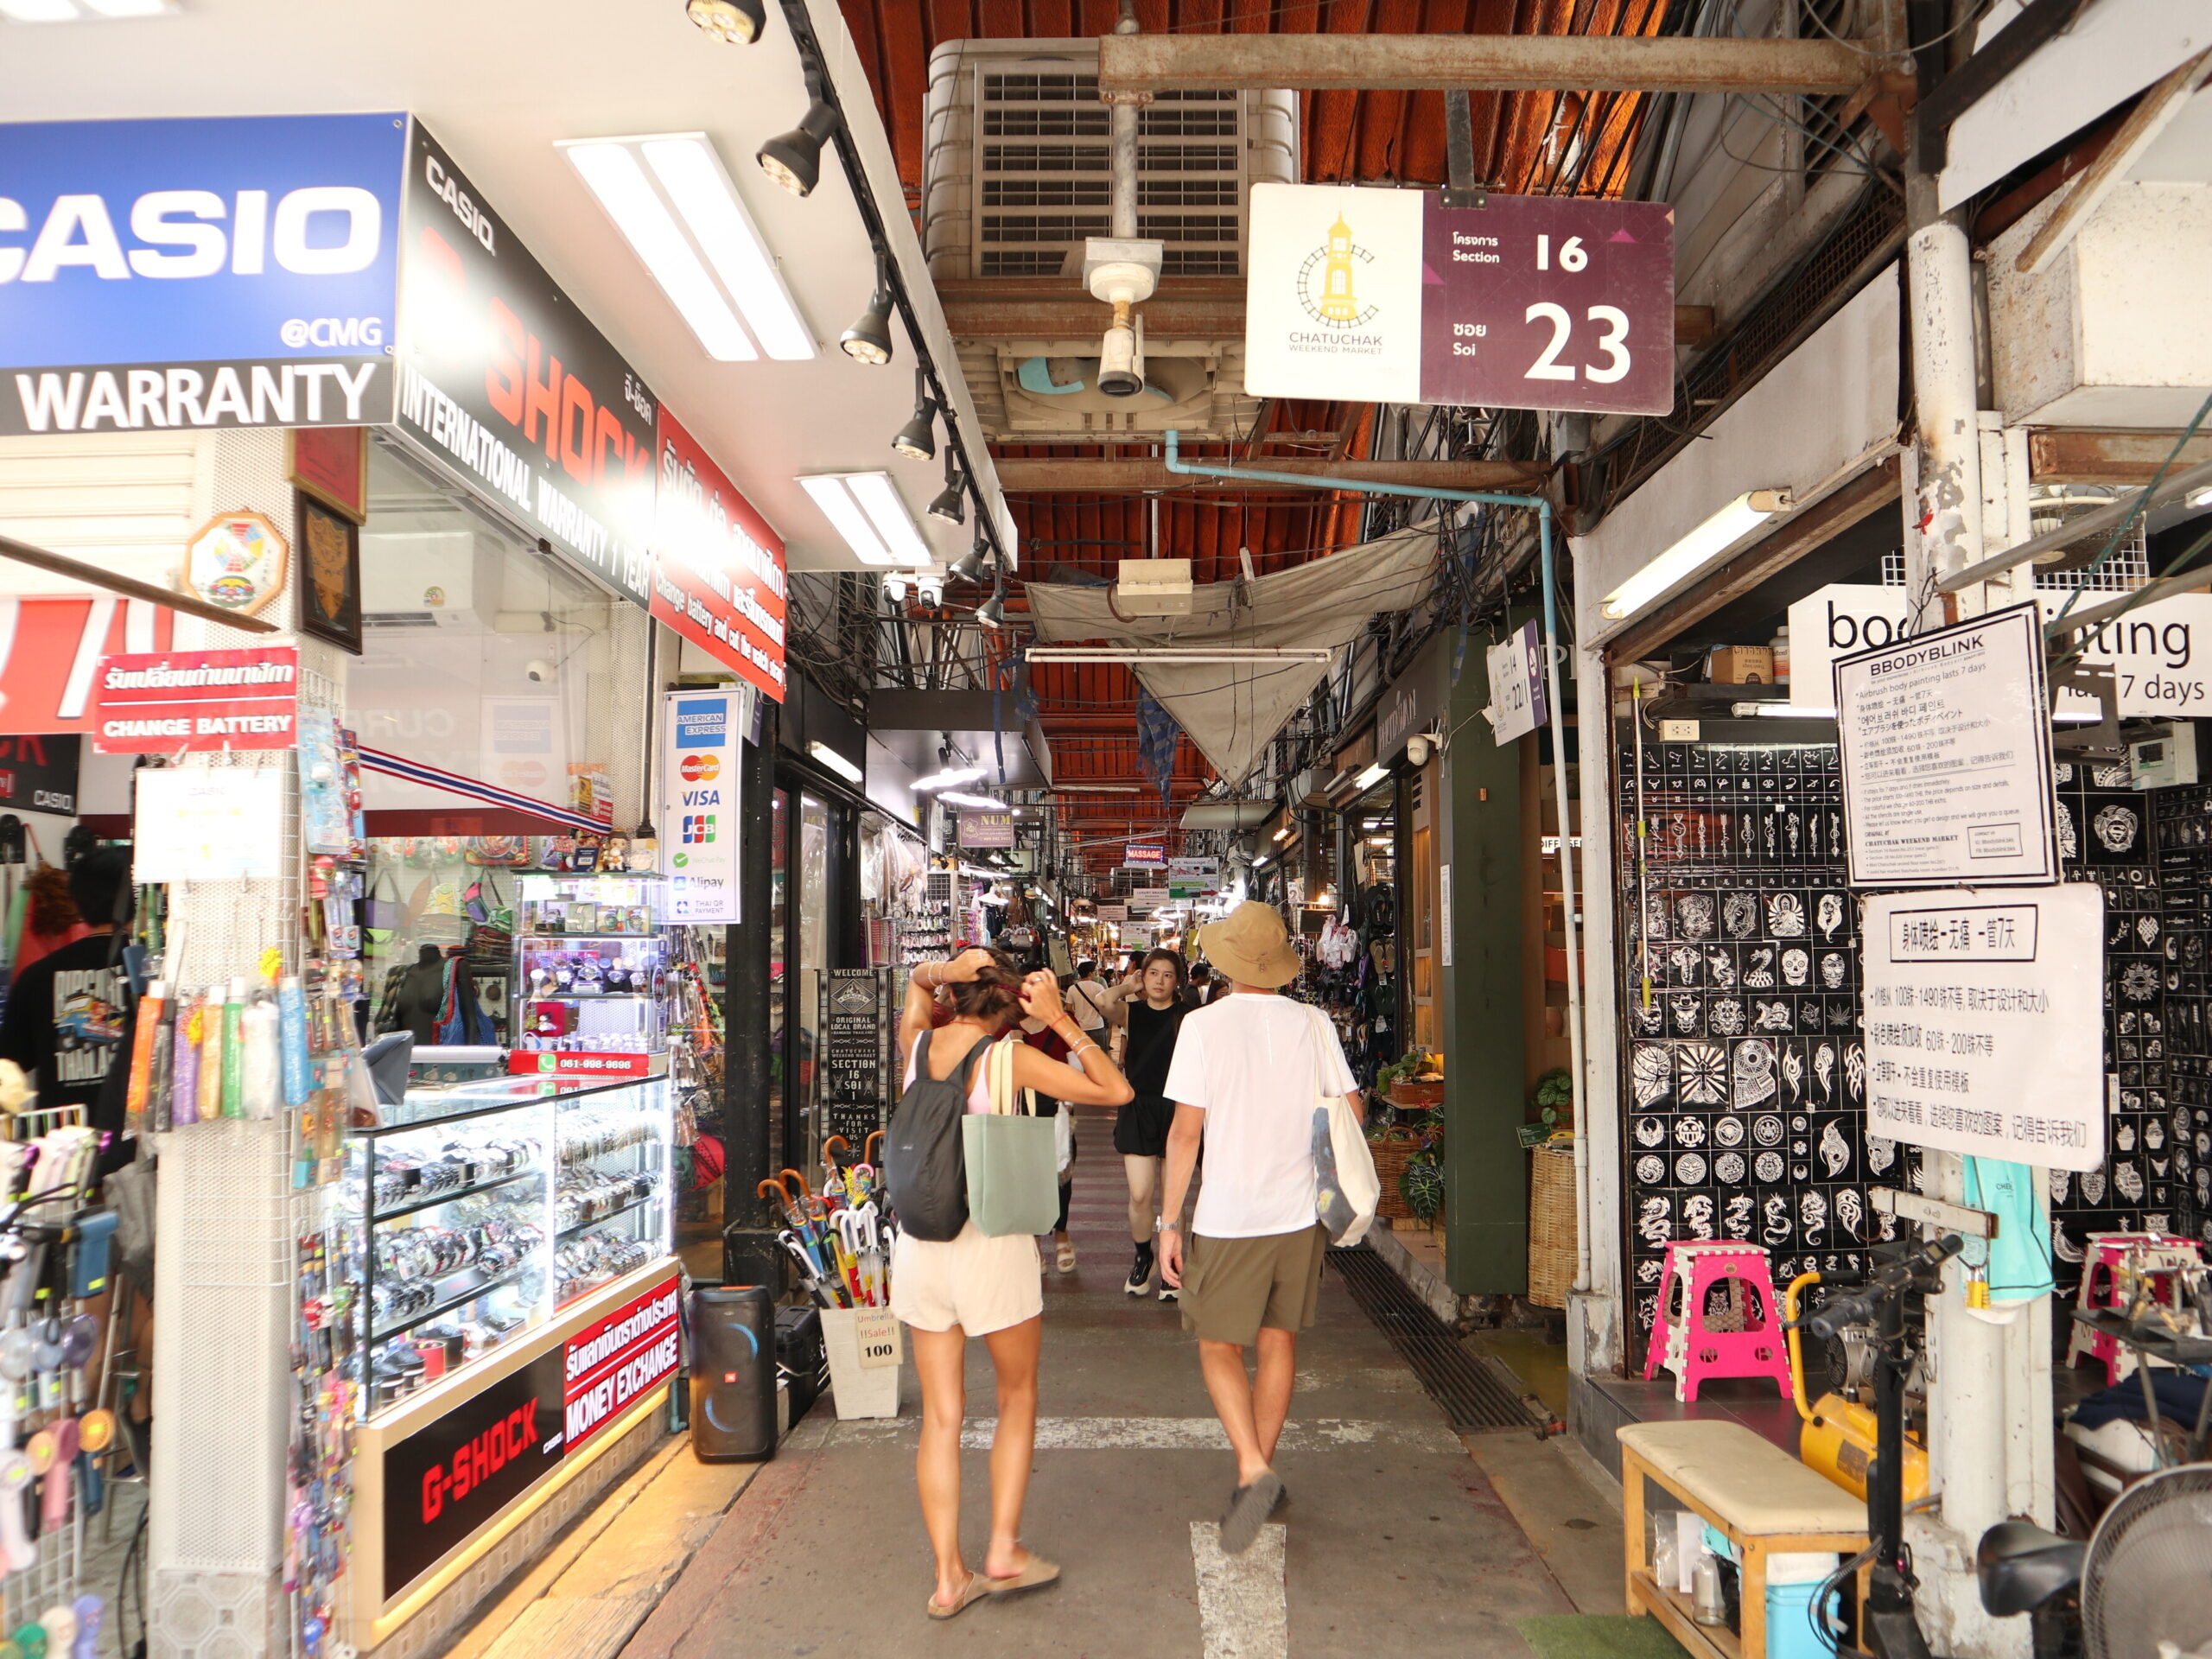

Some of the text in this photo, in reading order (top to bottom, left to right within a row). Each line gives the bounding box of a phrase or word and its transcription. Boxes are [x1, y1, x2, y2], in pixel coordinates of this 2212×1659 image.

[426, 156, 496, 257] CASIO
[1452, 232, 1588, 272] โครงการ 16
[1452, 250, 1500, 264] Section
[280, 318, 383, 347] @CMG
[1289, 332, 1382, 346] CHATUCHAK
[1288, 345, 1382, 355] WEEKEND MARKET
[1452, 343, 1476, 356] Soi
[1453, 302, 1631, 385] ซอย 23
[16, 363, 376, 431] WARRANTY
[402, 362, 531, 512] INTERNATIONAL
[537, 475, 608, 567] WARRANTY
[612, 539, 620, 576] 1
[623, 543, 650, 601] YEAR
[656, 567, 685, 613] Change
[687, 591, 713, 636] battery
[714, 617, 728, 643] and
[728, 628, 740, 652] cut
[741, 633, 751, 660] the
[752, 645, 769, 674] watch
[769, 659, 784, 687] strap
[1871, 634, 1984, 676] BBODYBLINK
[1890, 681, 1908, 691] body
[1909, 674, 1941, 690] painting
[1942, 670, 1959, 679] lasts
[1968, 663, 1986, 673] days
[2121, 675, 2135, 698] 7
[2145, 674, 2204, 706] days
[104, 715, 291, 737] CHANGE BATTERY
[677, 714, 722, 723] AMERICAN
[686, 725, 726, 734] EXPRESS
[681, 764, 720, 773] MasterCard
[34, 790, 73, 810] CASIO
[682, 790, 721, 806] VISA
[981, 815, 1011, 825] NUM
[683, 823, 715, 836] JCB
[1128, 850, 1161, 859] MASSAGE
[690, 876, 724, 890] Alipay
[831, 1059, 875, 1068] SECTION
[849, 1071, 859, 1079] 16
[858, 1313, 893, 1324] Umbrella
[860, 1327, 894, 1338] !!Sale!!
[864, 1344, 893, 1357] 100
[566, 1331, 677, 1443] MONEY EXCHANGE
[543, 1432, 563, 1454] CASIO
[423, 1396, 539, 1524] G-SHOCK
